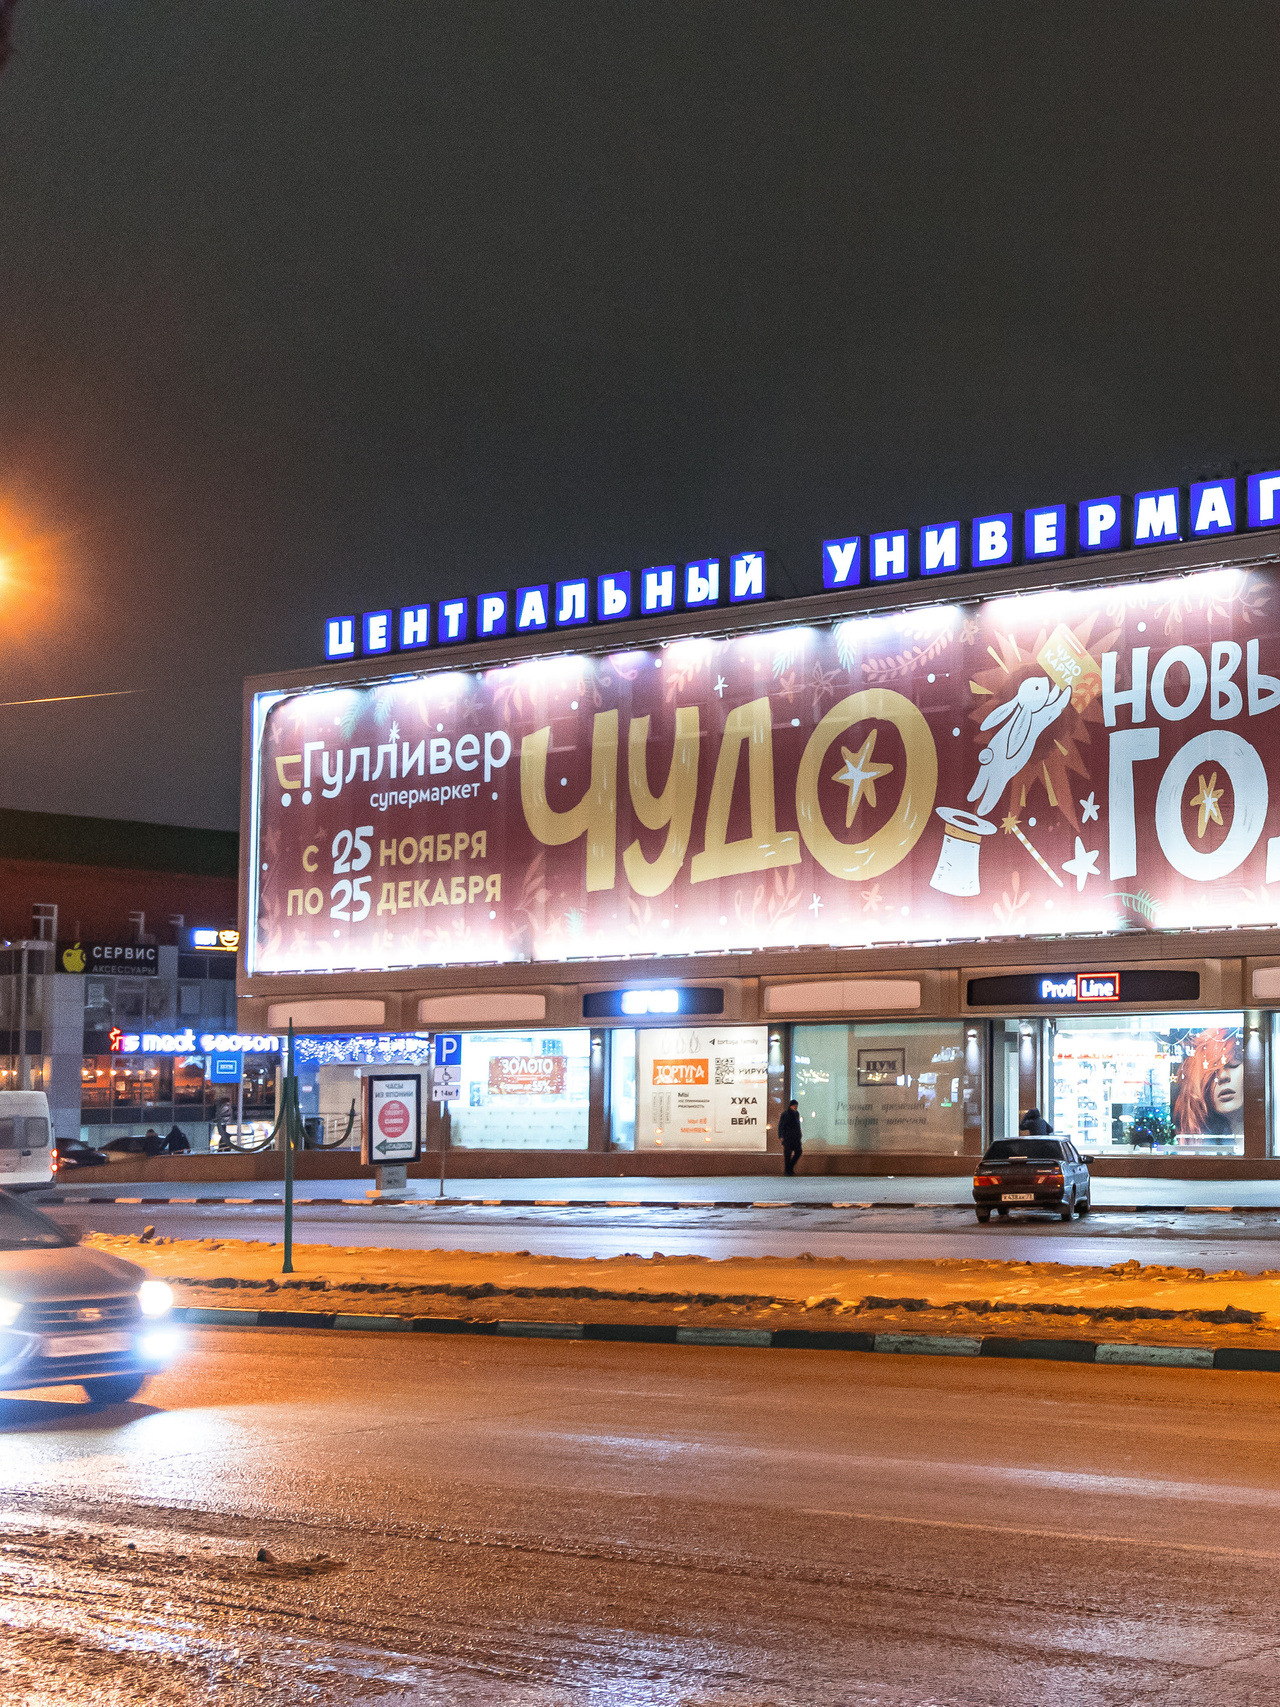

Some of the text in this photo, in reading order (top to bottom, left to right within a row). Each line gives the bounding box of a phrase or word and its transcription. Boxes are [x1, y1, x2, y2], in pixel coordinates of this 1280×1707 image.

[327, 553, 764, 657] ЦЕНТРАЛЬНЫЙ
[1045, 649, 1073, 685] КАРТА
[1057, 644, 1082, 676] ЧУДО
[303, 729, 512, 799] Гулливер
[370, 782, 481, 811] супермаркет
[520, 687, 938, 897] ЧУДО
[302, 825, 487, 875] С 25 НОЯБРЯ
[287, 874, 501, 923] ПО 25 ДЕКАБРЯ
[92, 946, 156, 961] СЕРВИС
[91, 964, 156, 975] АКСЕССУАРЫ
[1041, 978, 1114, 998] Profi Line
[143, 1028, 196, 1051] meat
[200, 1034, 279, 1051] season
[442, 1037, 458, 1063] P
[500, 1057, 554, 1076] ЗОЛОТО
[656, 1064, 705, 1079] ТОРТУГА
[731, 1116, 757, 1126] ВЕЙП
